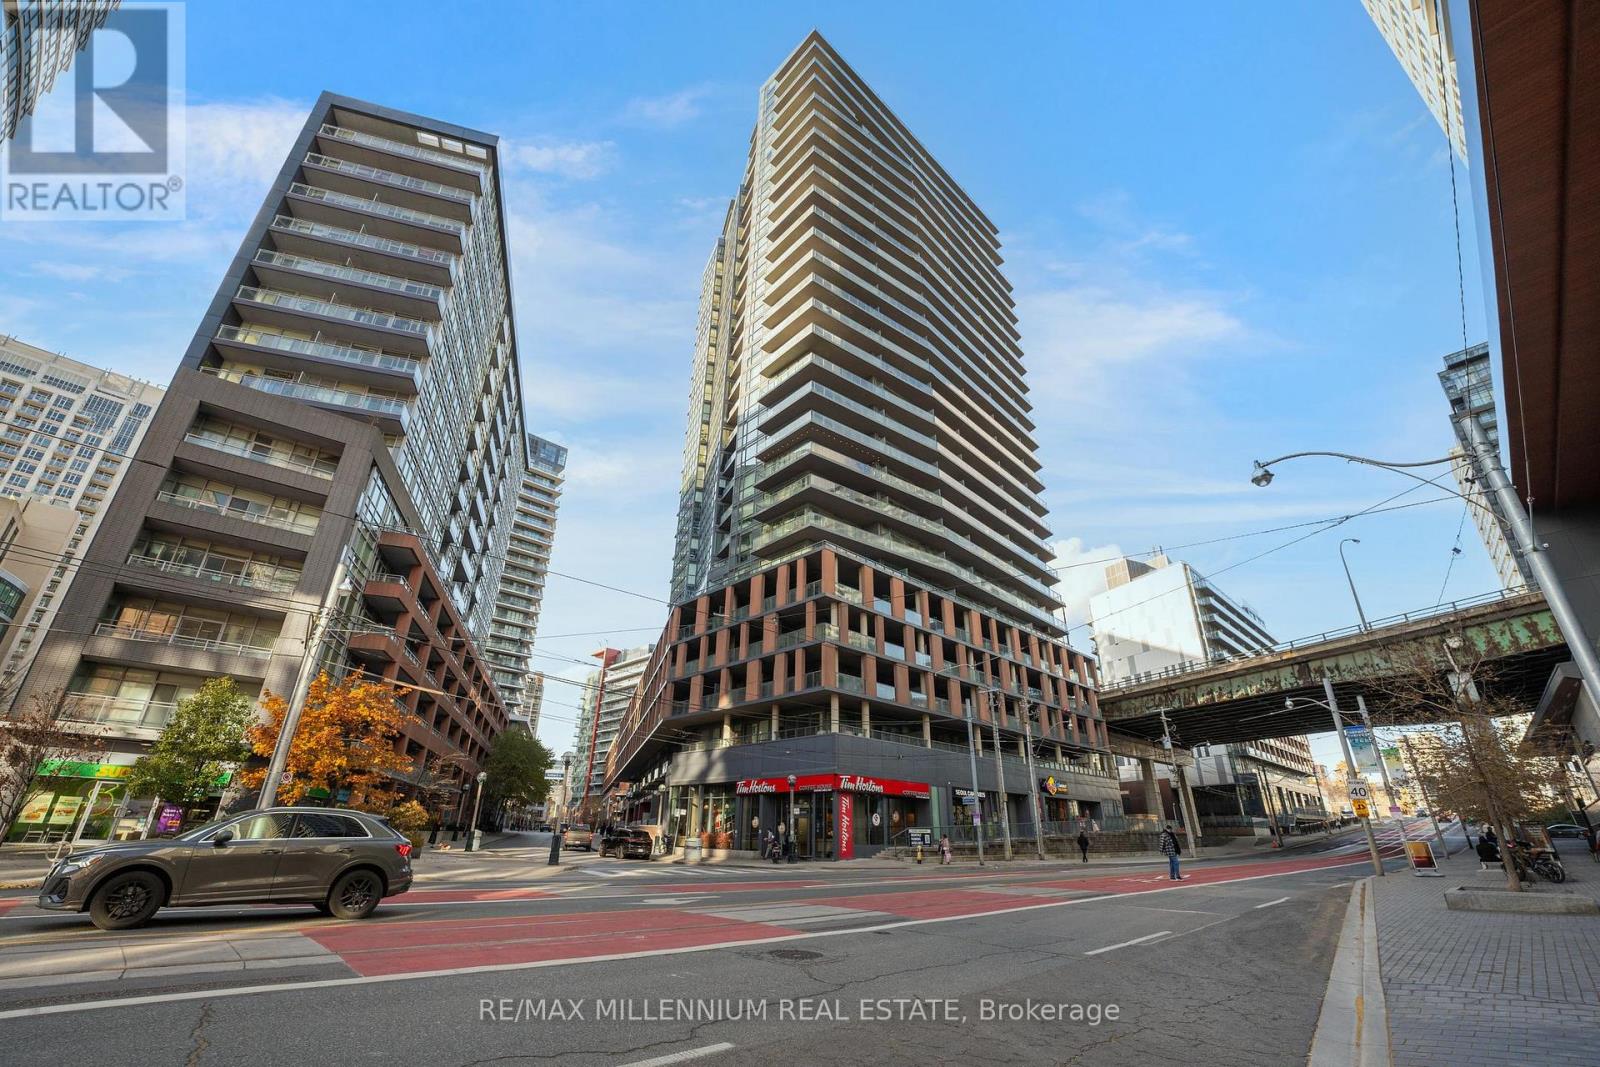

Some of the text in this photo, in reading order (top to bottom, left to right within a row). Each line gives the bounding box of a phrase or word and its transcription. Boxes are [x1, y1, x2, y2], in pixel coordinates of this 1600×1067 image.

[736, 779, 776, 794] Tim Hortons
[840, 775, 883, 793] Tim Hortons
[1351, 787, 1367, 797] 40
[841, 796, 850, 852] Tim Hortons
